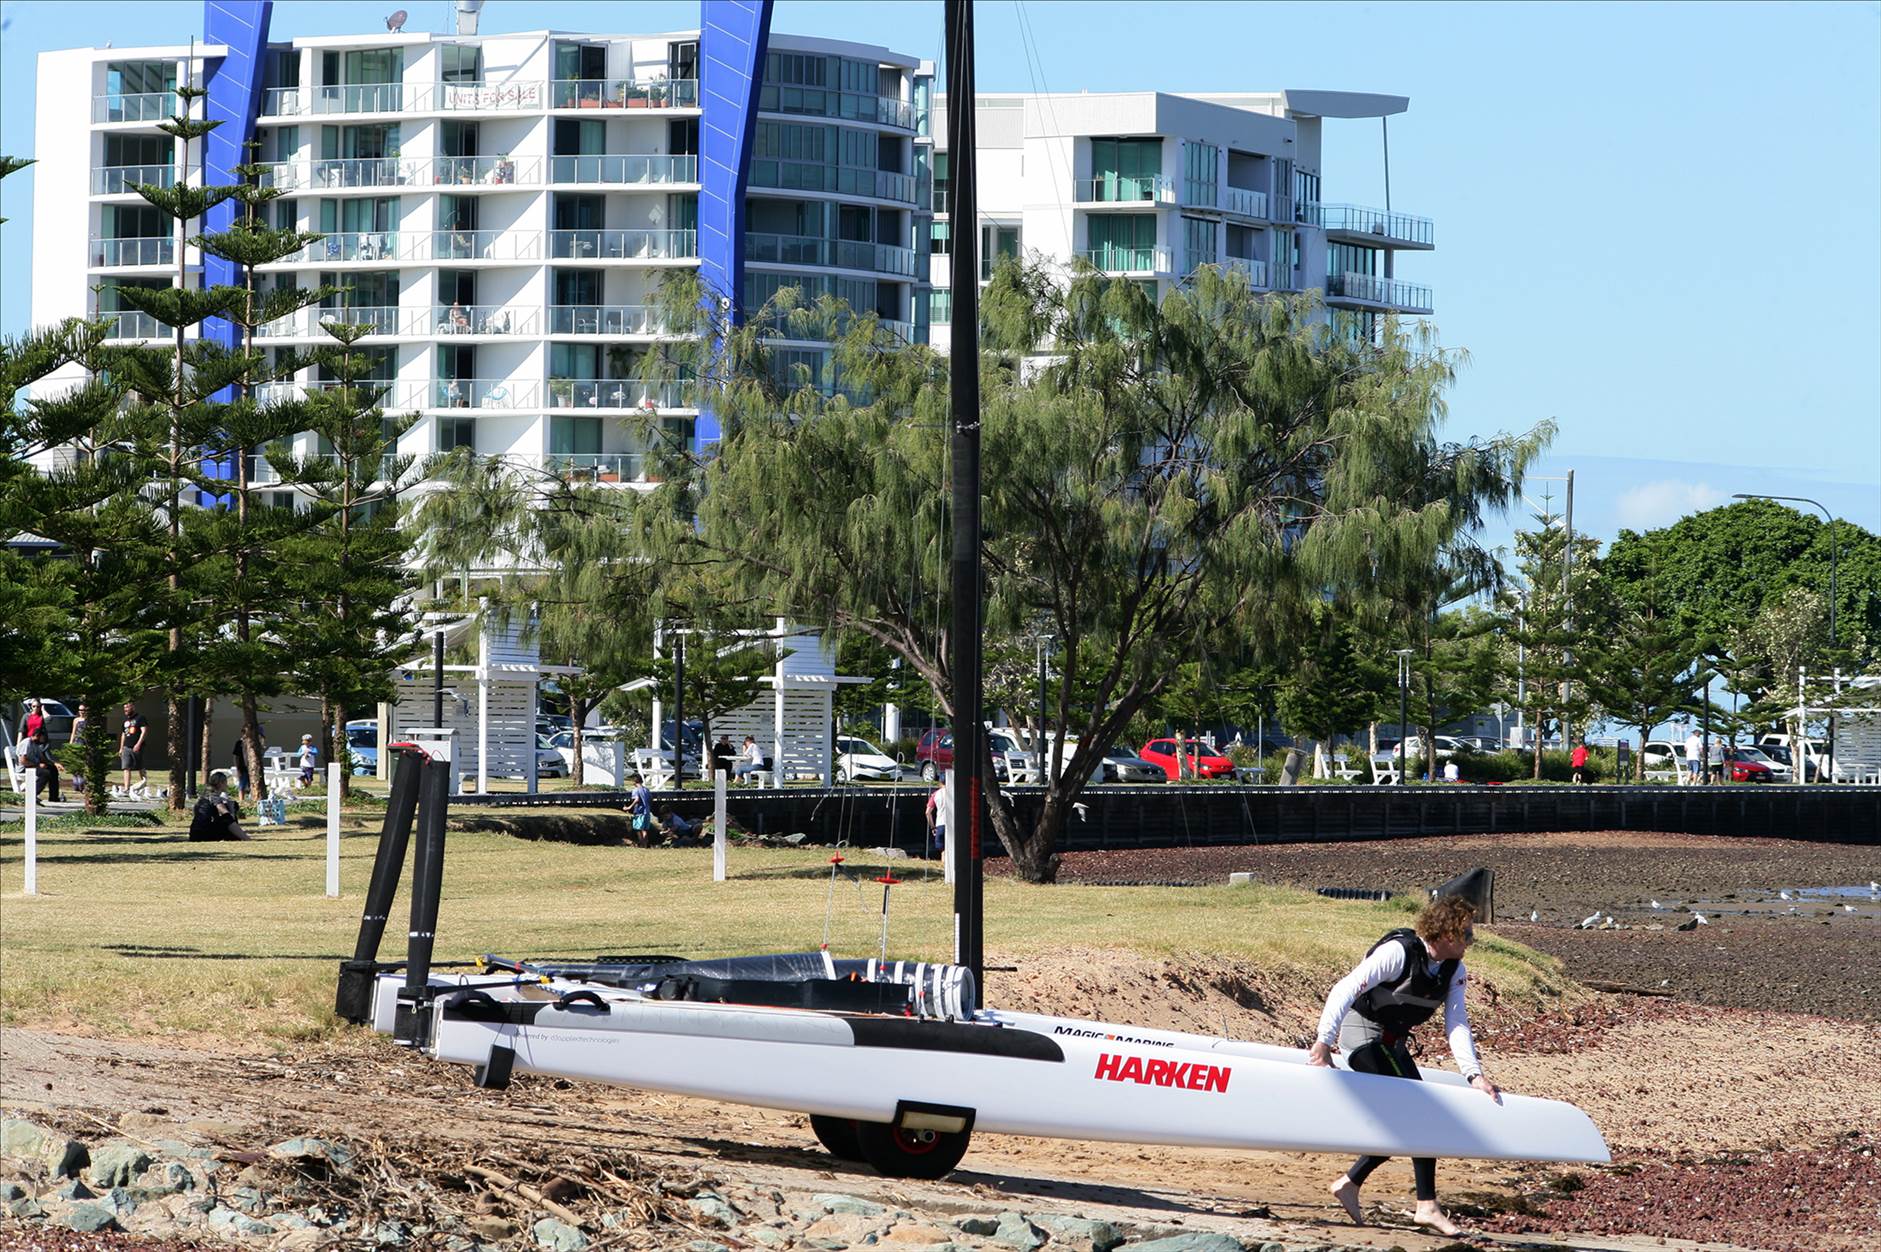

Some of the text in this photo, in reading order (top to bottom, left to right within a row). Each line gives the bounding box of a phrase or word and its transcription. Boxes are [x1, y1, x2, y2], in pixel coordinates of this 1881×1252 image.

[448, 87, 536, 105] UNITS FOR SALE
[540, 1032, 548, 1042] by
[1053, 1025, 1105, 1039] MAGIC
[1094, 1053, 1232, 1093] HARKEN
